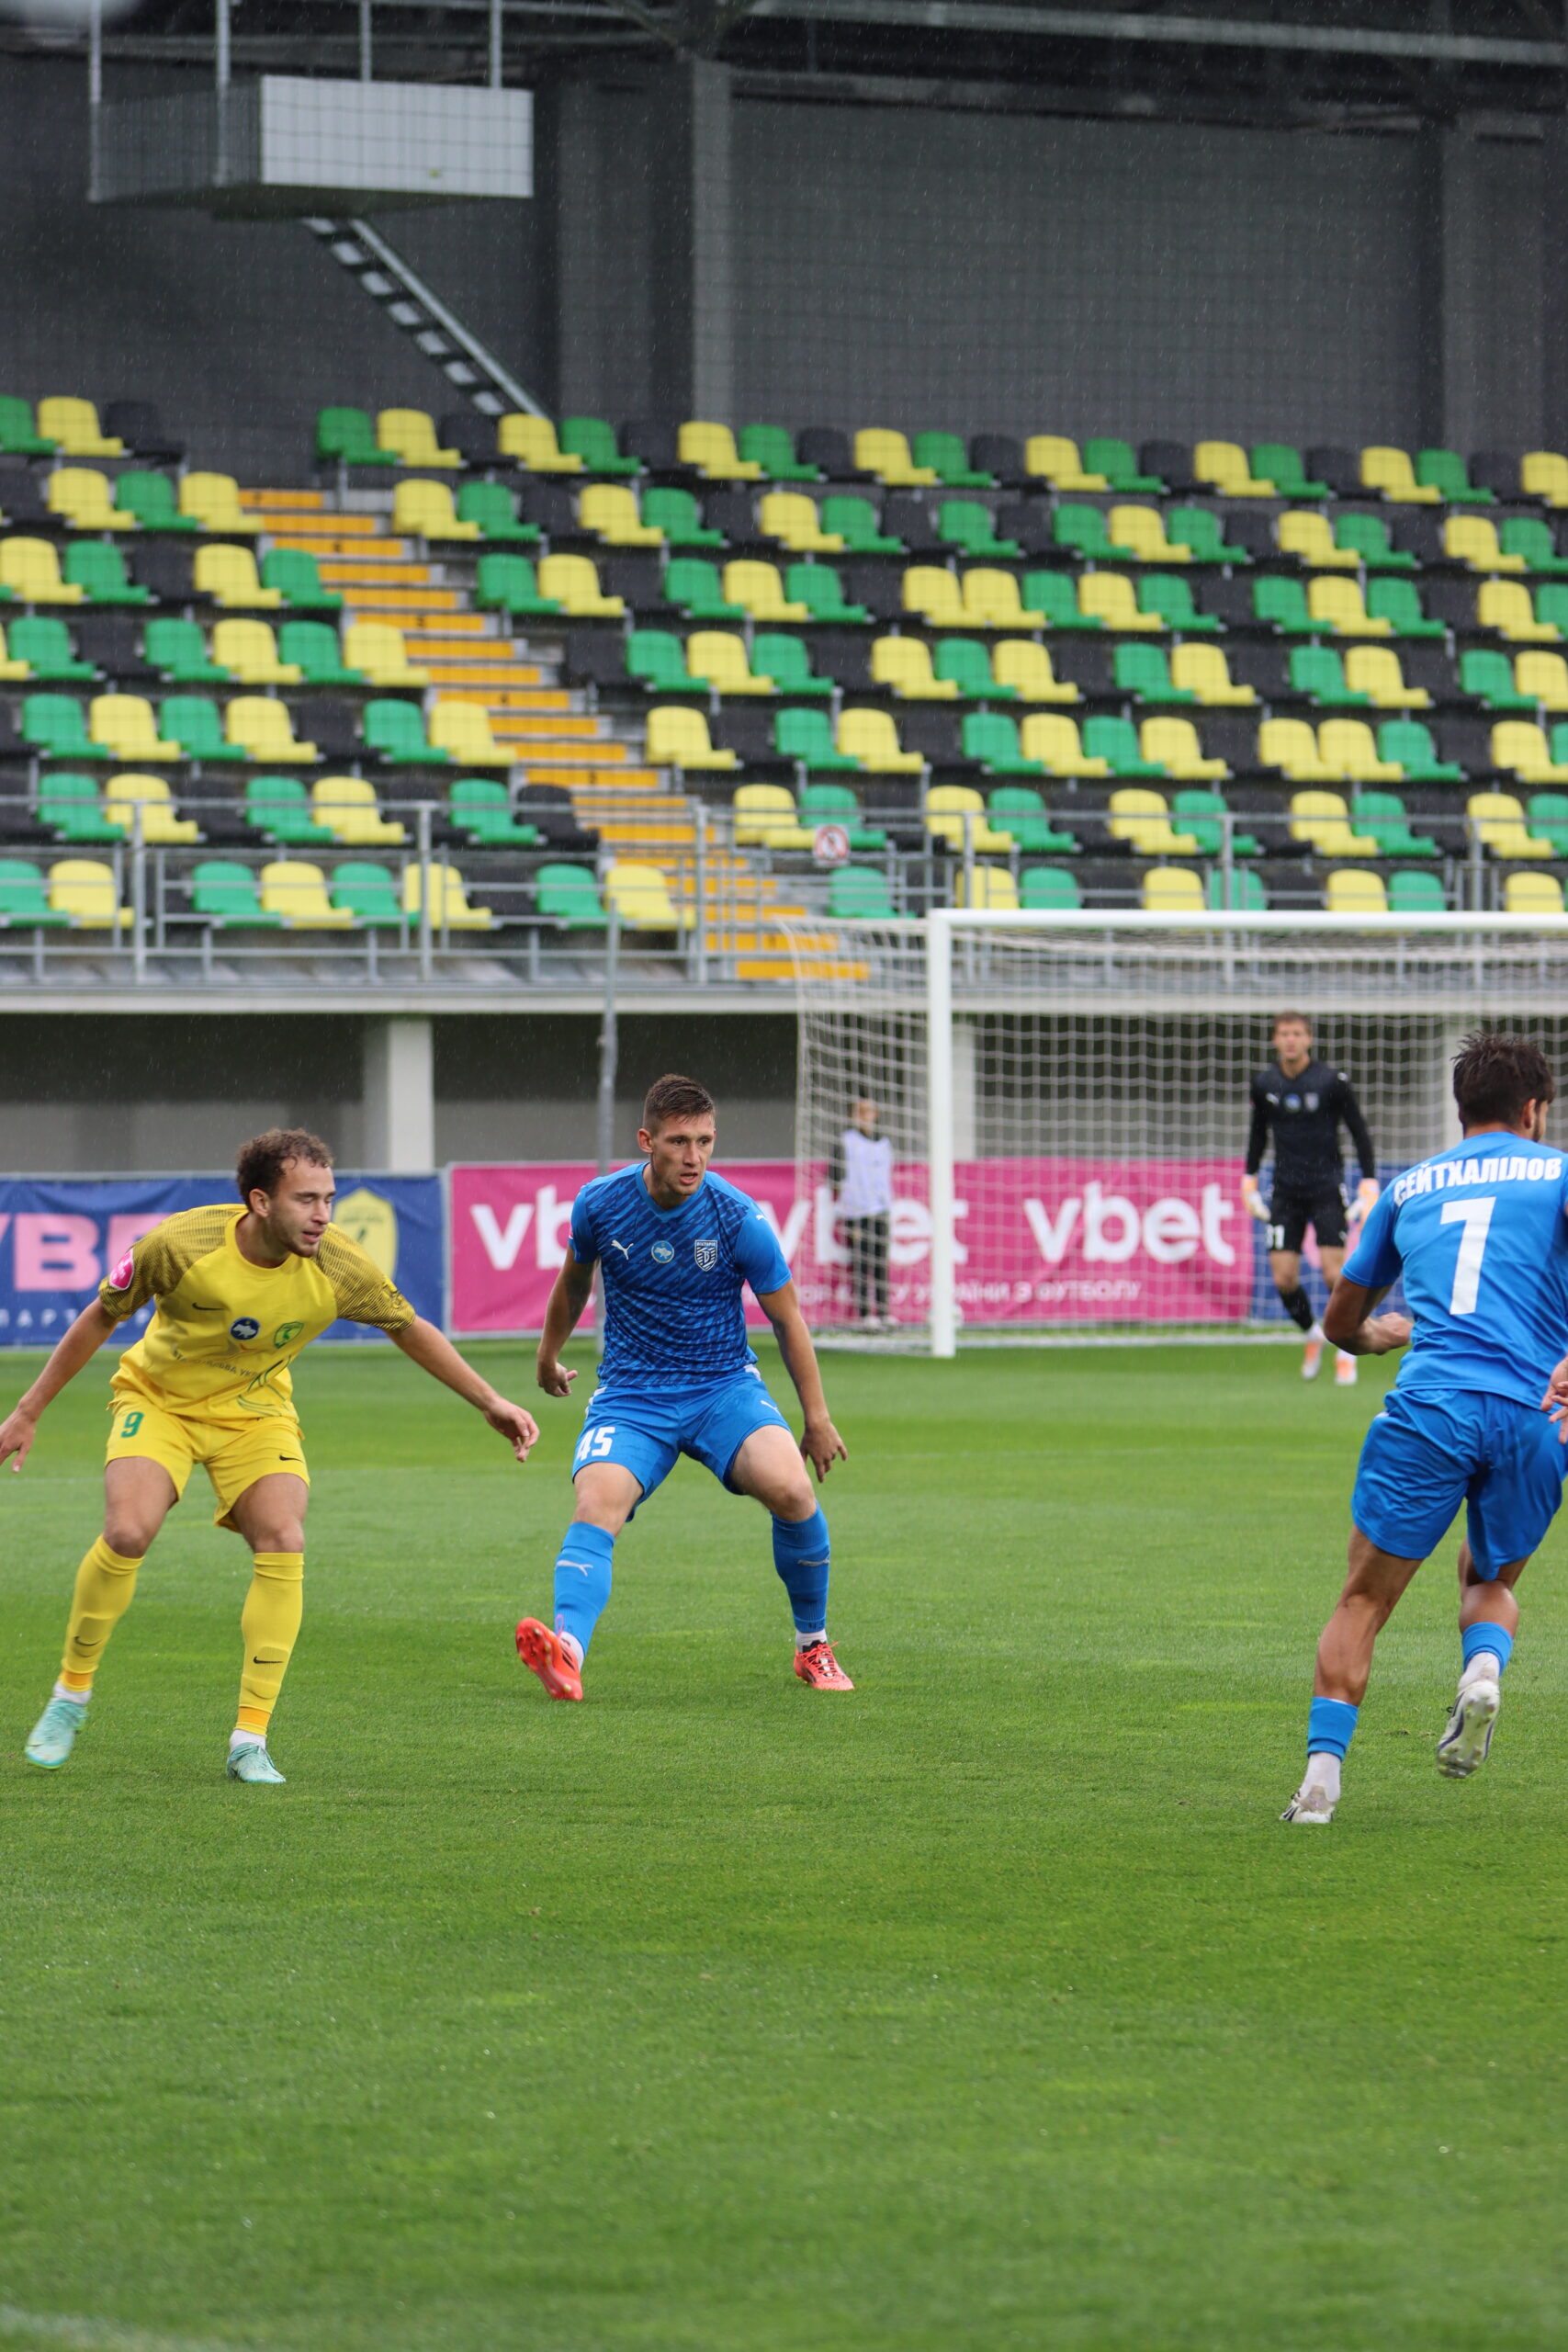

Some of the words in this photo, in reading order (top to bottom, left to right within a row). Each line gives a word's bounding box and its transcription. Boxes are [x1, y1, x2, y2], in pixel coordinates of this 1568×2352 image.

[469, 1184, 576, 1271] vb
[1023, 1180, 1235, 1266] vbet
[1439, 1196, 1496, 1316] 7
[120, 1411, 144, 1438] 9
[577, 1426, 616, 1462] 45
